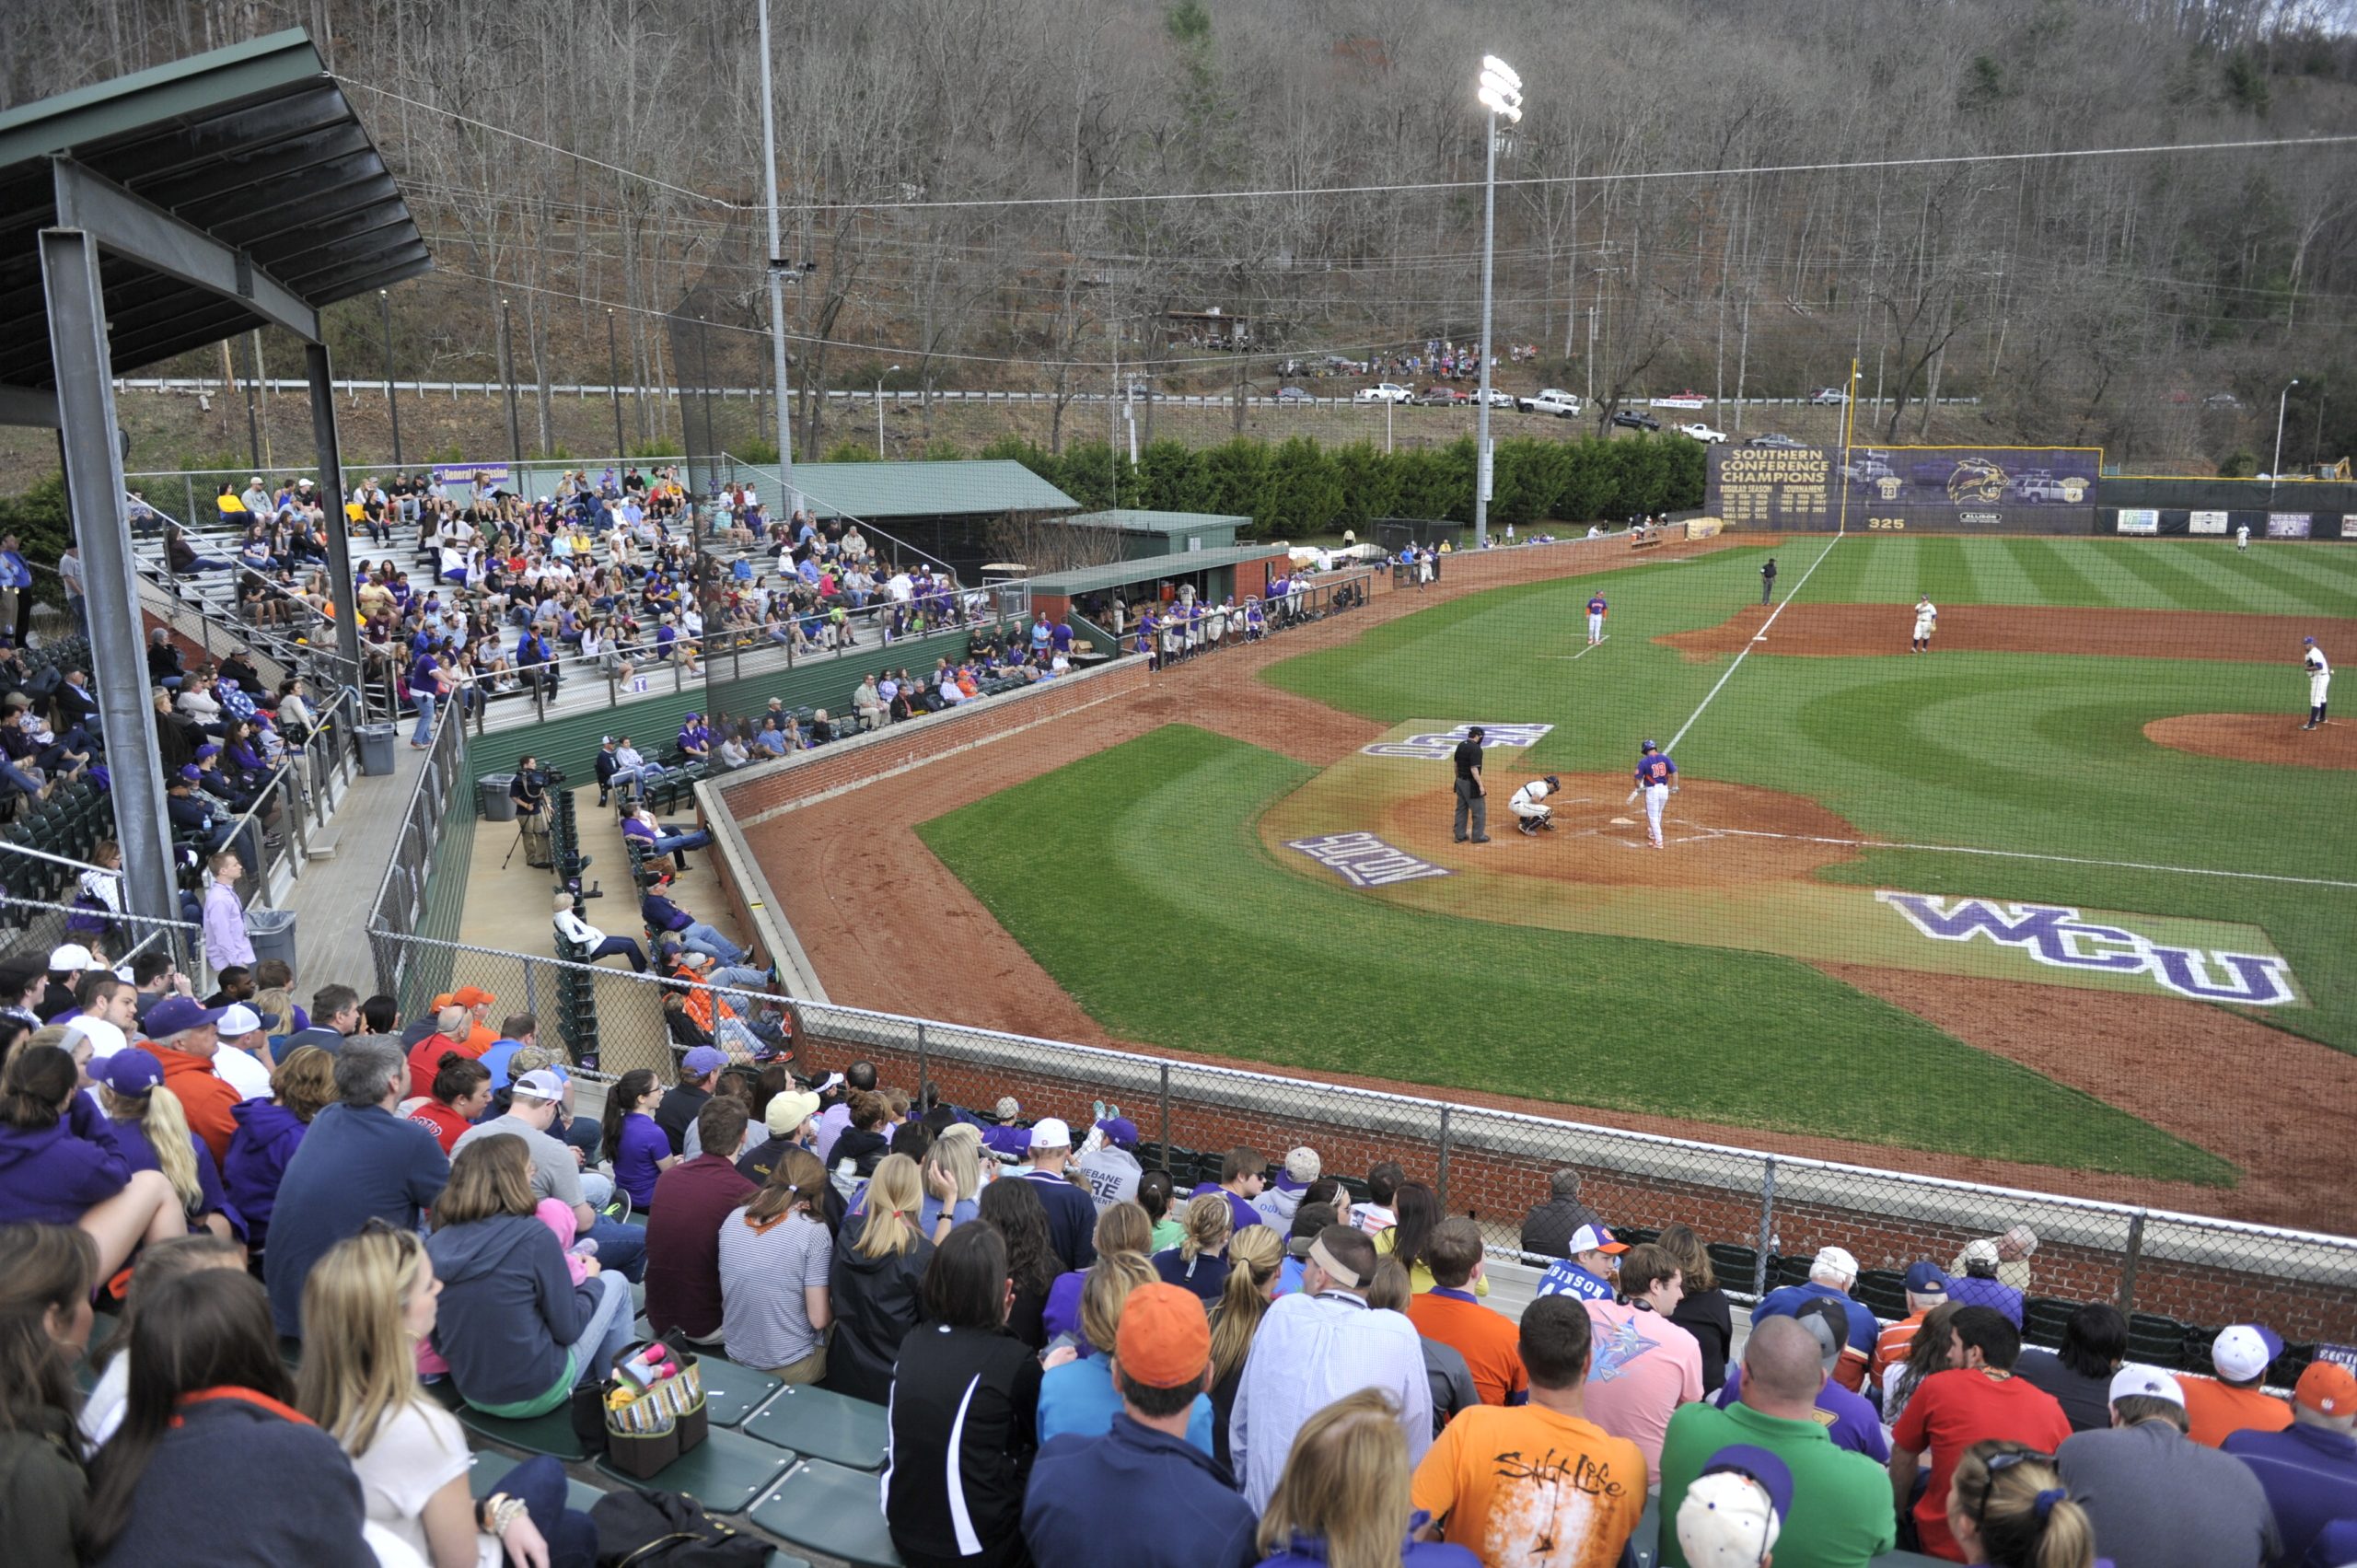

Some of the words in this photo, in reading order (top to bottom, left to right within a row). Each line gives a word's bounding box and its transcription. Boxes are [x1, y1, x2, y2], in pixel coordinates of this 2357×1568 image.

[1732, 449, 1823, 460] SOUTHERN
[1721, 460, 1829, 471] CONFERENCE
[444, 469, 471, 480] General
[1722, 471, 1826, 482] CHAMPIONS
[1748, 484, 1772, 493] SEASON
[1783, 484, 1825, 493] TOURNAMENT
[1883, 486, 1895, 496] 23
[1868, 517, 1905, 529] 325
[1875, 890, 2296, 1005] WCU
[1091, 1179, 1119, 1201] RE
